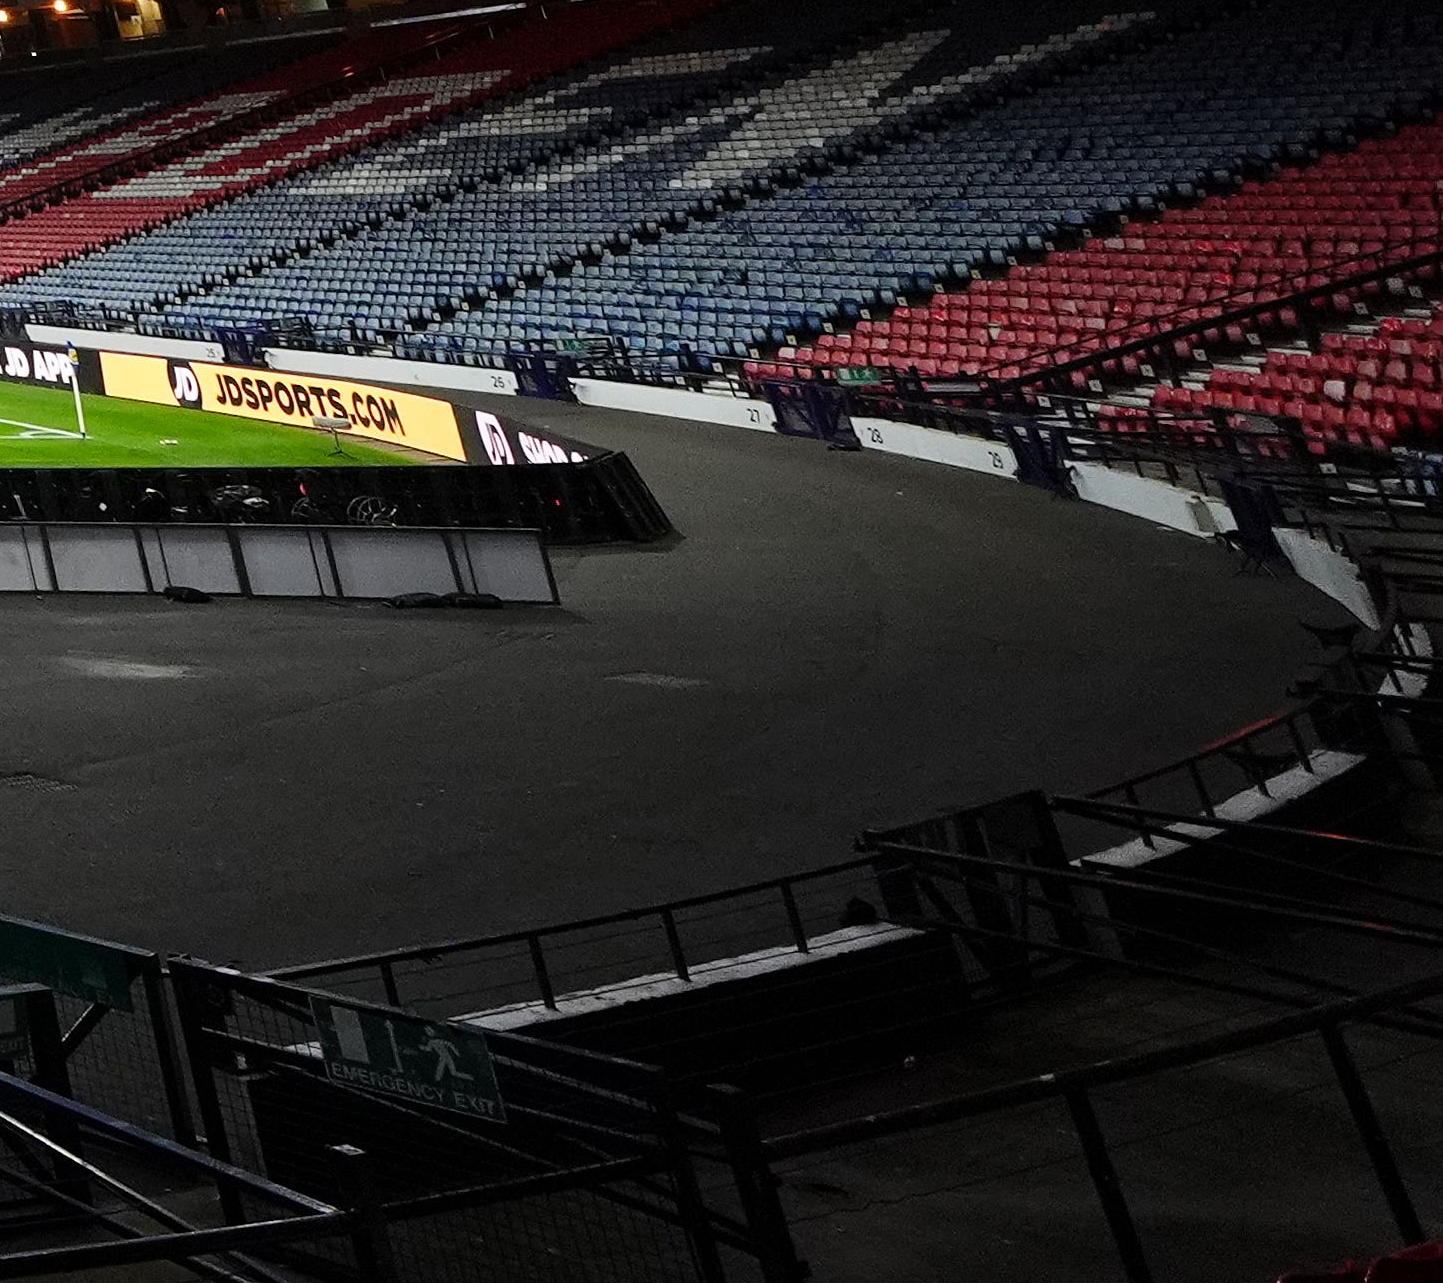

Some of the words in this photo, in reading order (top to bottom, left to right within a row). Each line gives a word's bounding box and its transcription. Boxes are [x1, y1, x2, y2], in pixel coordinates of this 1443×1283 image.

[5, 347, 29, 378] JD
[33, 350, 73, 384] APP
[490, 376, 505, 389] 26
[173, 366, 199, 402] JD
[216, 373, 406, 437] JDSPORTS.COM
[746, 408, 761, 425] 27
[870, 427, 884, 445] 28
[987, 450, 1004, 470] 29
[331, 1063, 444, 1103] EMERGENCY
[453, 1091, 495, 1115] EXIT
